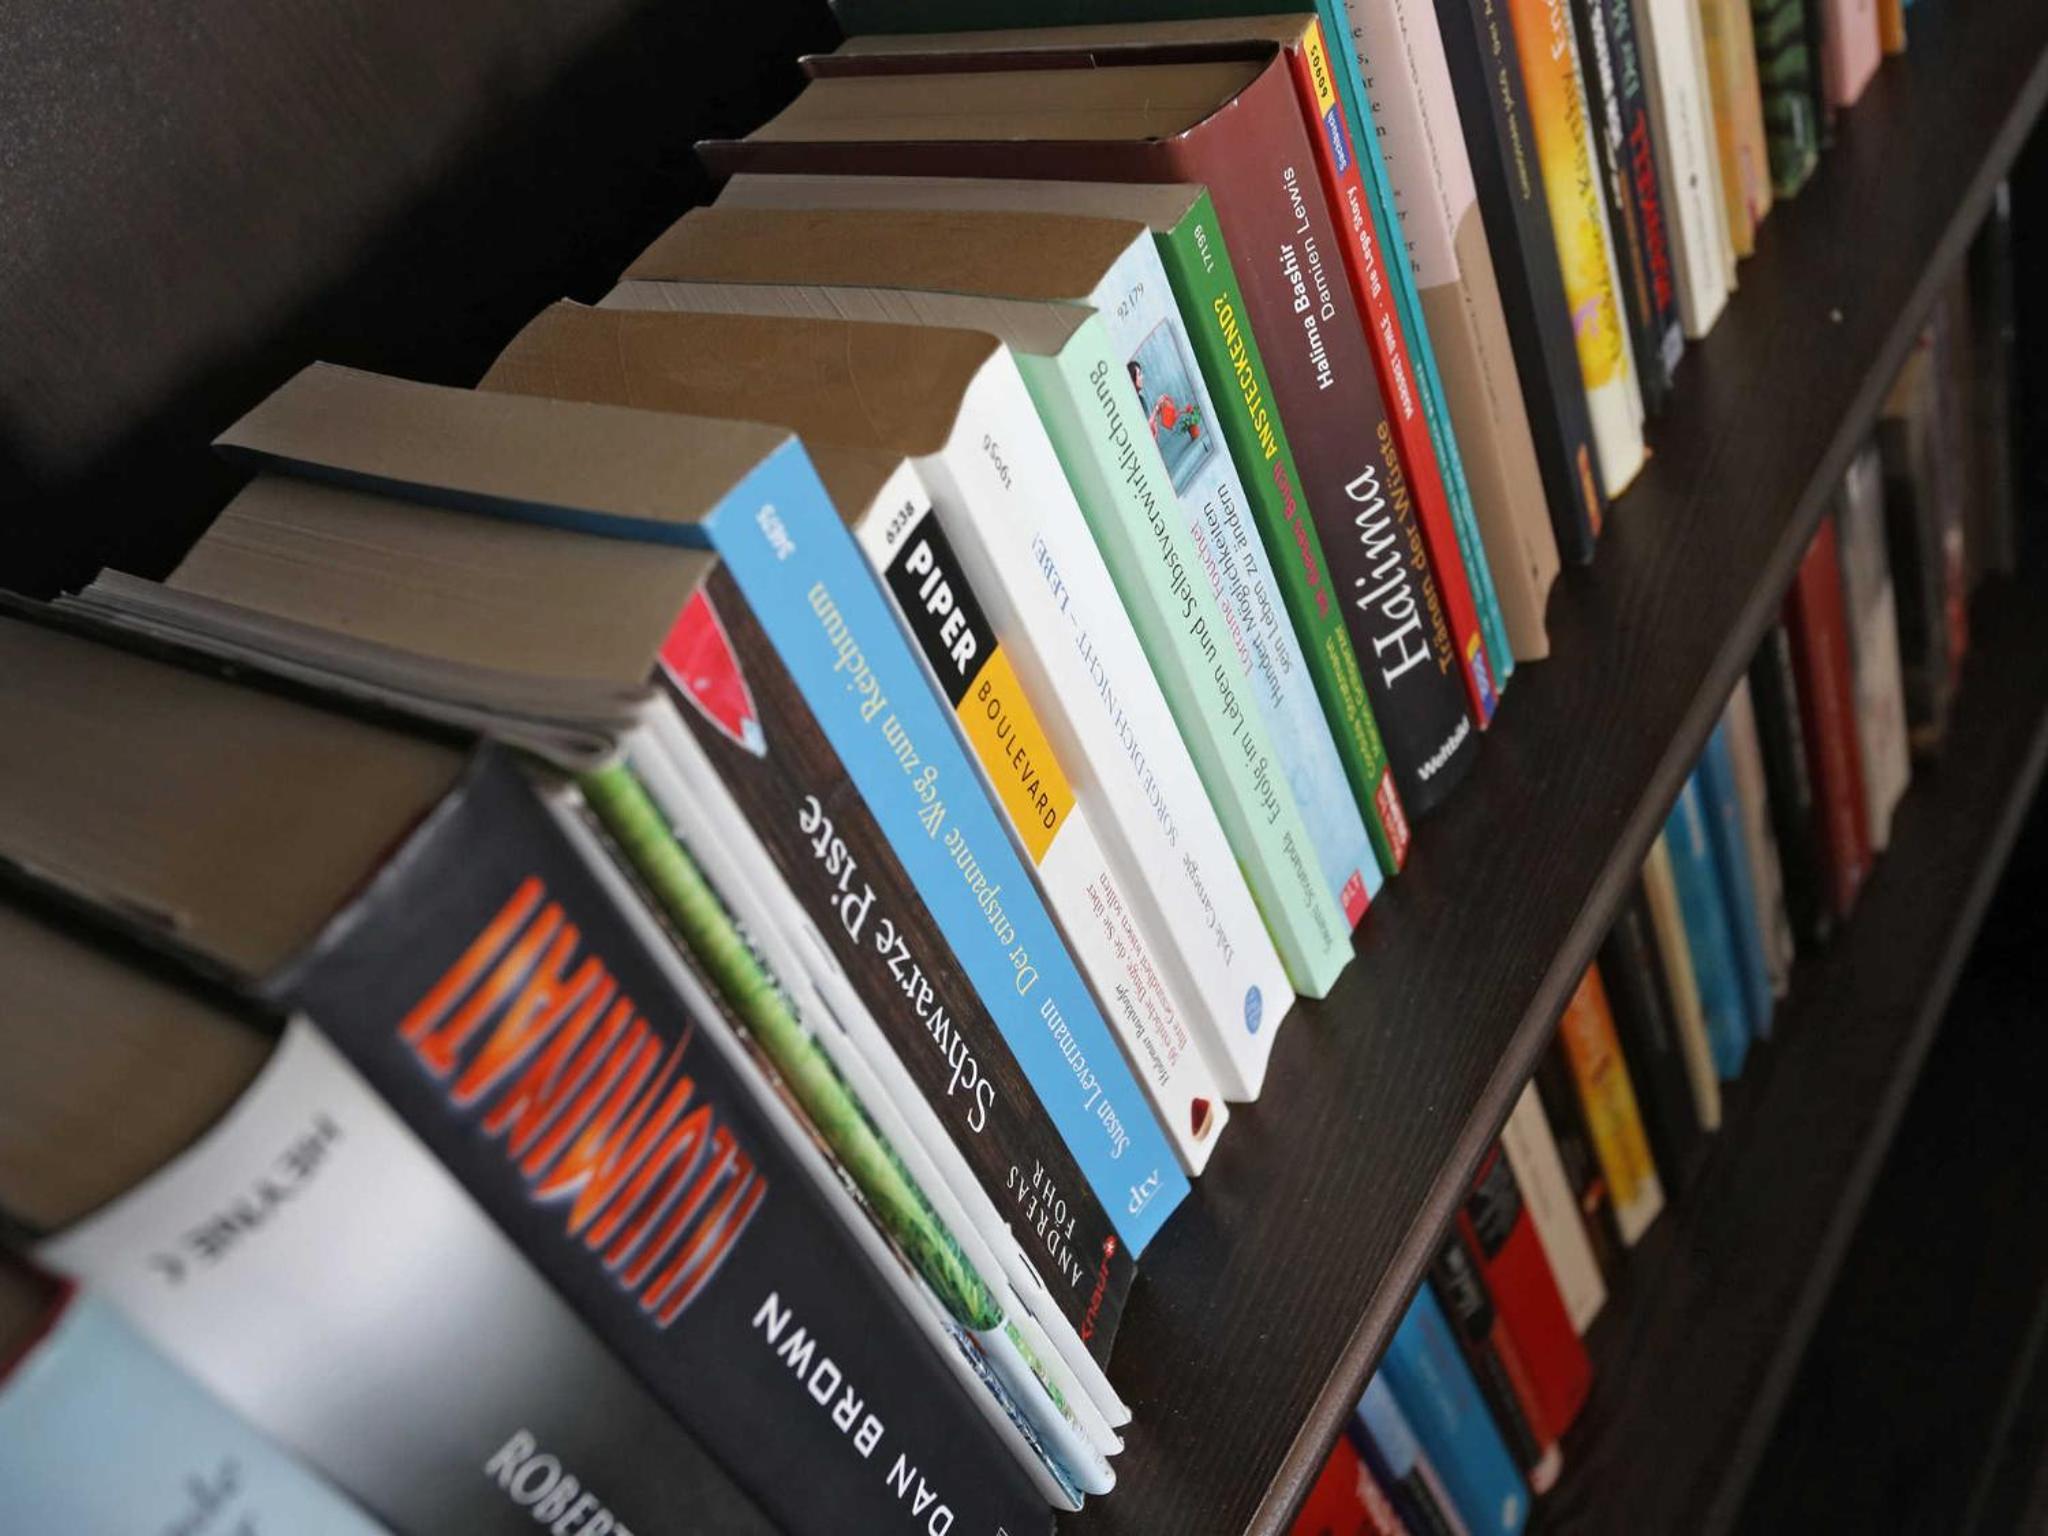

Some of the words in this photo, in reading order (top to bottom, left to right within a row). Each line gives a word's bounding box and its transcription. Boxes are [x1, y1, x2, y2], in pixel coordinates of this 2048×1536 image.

[1307, 44, 1328, 97] 60905
[1281, 166, 1310, 233] Lewis
[1345, 188, 1363, 229] Story
[1279, 244, 1310, 313] Bashir
[1303, 237, 1335, 321] Damien
[1358, 229, 1374, 270] Lego
[1366, 270, 1382, 297] Die
[1213, 292, 1278, 459] ANSTECKEND?
[1304, 314, 1333, 389] Halima
[981, 433, 1012, 491] 19056
[1089, 360, 1200, 618] Selbstverwirklichung
[1271, 460, 1297, 520] Buch
[1374, 422, 1411, 513] Wüste
[1216, 483, 1247, 552] ändern
[1405, 524, 1428, 570] der
[1030, 531, 1071, 615] LEBE!
[1188, 518, 1224, 600] Fouchet
[1202, 501, 1257, 633] Möglichkeiten
[1242, 552, 1257, 576] zu
[1344, 463, 1431, 688] Halima
[902, 537, 982, 675] PIPER
[1189, 616, 1217, 660] und
[1223, 600, 1254, 675] Lorraine
[1252, 580, 1278, 638] Leben
[1419, 575, 1455, 675] Tränen
[809, 580, 887, 722] Reichtum
[1074, 630, 1116, 712] NICHT
[1249, 632, 1285, 708] Hundert
[1275, 636, 1293, 675] sein
[1213, 664, 1244, 735] Leben
[883, 715, 920, 772] zum
[976, 681, 1058, 830] BOULEVARD
[1115, 710, 1145, 775] DICH
[1241, 732, 1257, 768] im
[911, 763, 947, 838] Weg
[1141, 769, 1180, 847] SORGE
[1251, 756, 1281, 824] Erfolg
[799, 793, 875, 944] Piste
[941, 827, 1015, 946] entspannte
[1085, 884, 1105, 916] über
[1181, 853, 1218, 928] Carnegie
[1101, 914, 1116, 940] Sie
[1112, 937, 1125, 959] die
[1006, 946, 1040, 996] Der
[869, 917, 999, 1133] Schwarze
[1115, 983, 1145, 1038] Bankhofer
[1039, 997, 1103, 1110] Levermann
[398, 876, 767, 1328] ILLUMINATI
[1095, 1101, 1131, 1159] Susan
[1003, 1163, 1083, 1286] ANDREAS
[1028, 1157, 1081, 1239] FÖHR
[1128, 1168, 1161, 1216] dtv
[752, 1291, 884, 1458] BROWN
[885, 1453, 954, 1536] DAN
